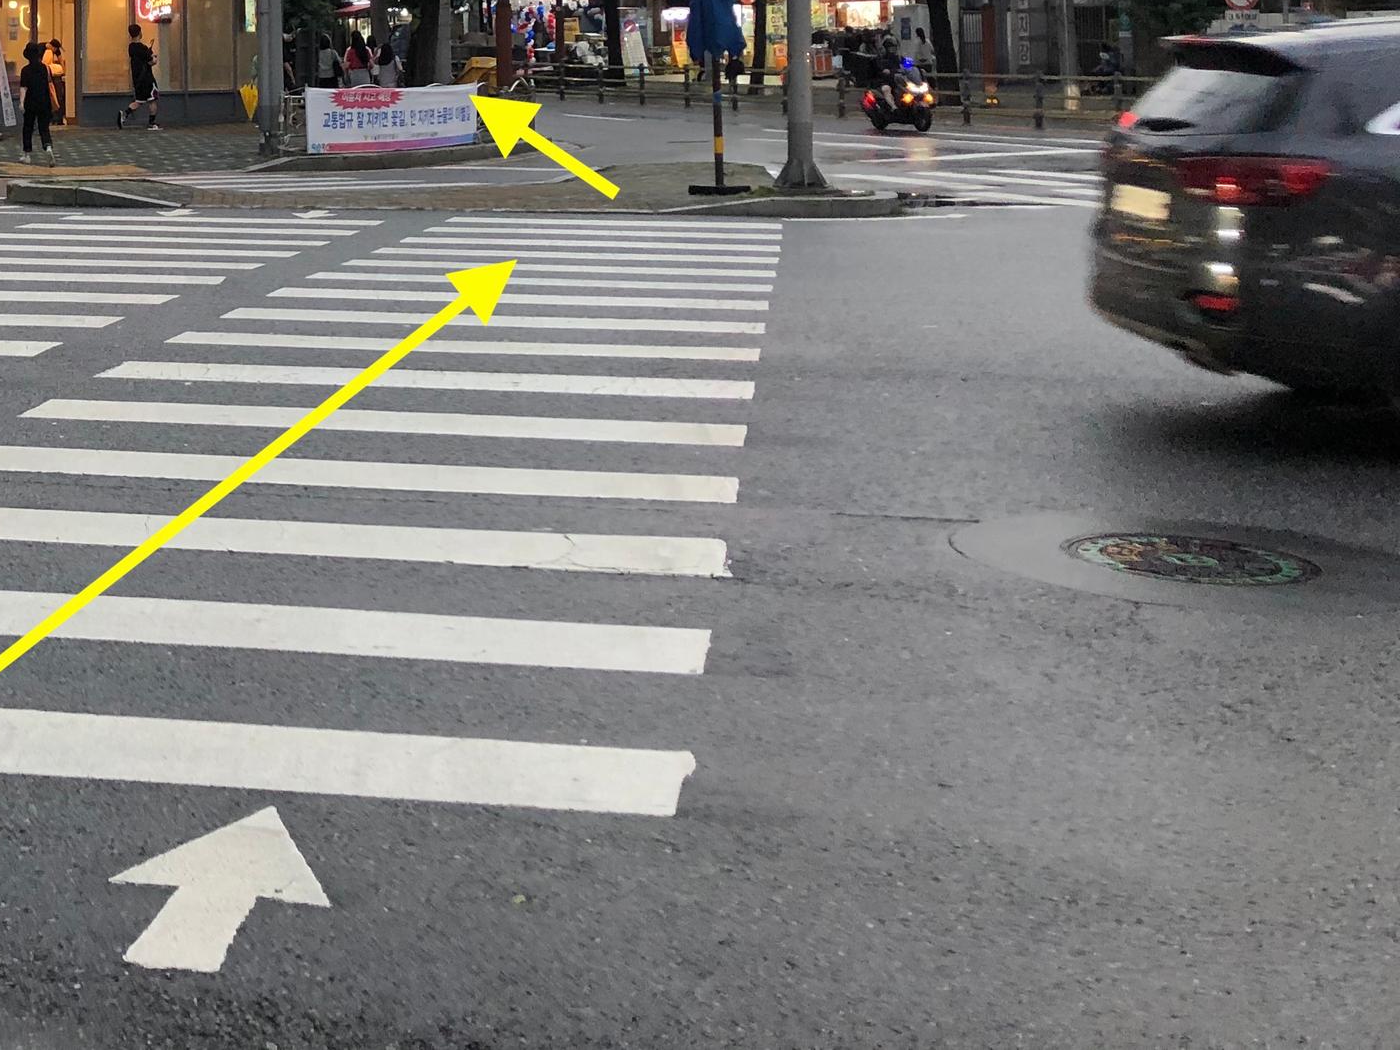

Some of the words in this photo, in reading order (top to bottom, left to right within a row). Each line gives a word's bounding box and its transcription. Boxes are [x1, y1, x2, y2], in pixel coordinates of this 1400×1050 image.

[323, 111, 354, 129] 교통법규
[357, 111, 364, 128] 잘
[367, 111, 389, 128] 지키면
[410, 110, 416, 126] 안
[418, 109, 435, 125] 지키면
